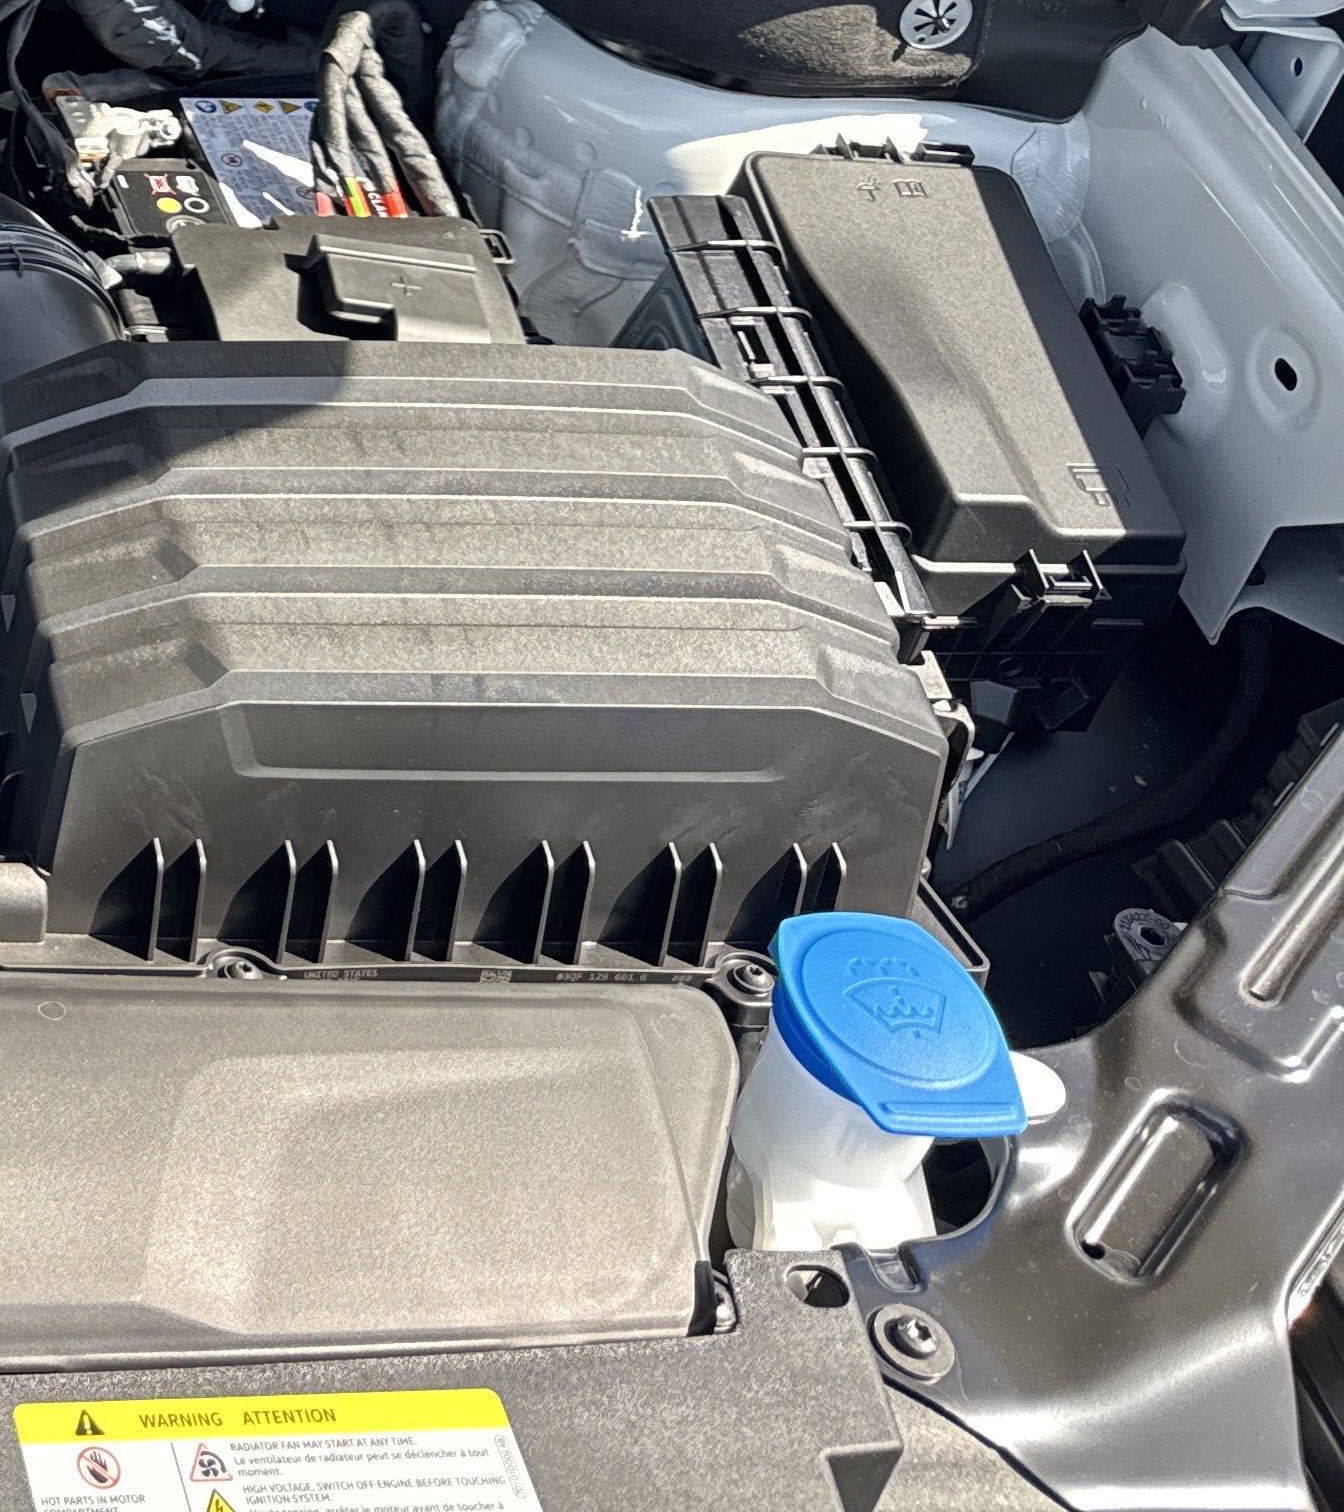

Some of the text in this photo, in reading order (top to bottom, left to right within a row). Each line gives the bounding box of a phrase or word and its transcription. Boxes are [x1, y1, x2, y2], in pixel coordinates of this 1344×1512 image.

[138, 1408, 336, 1429] WARNING ATTENTION
[230, 1440, 278, 1452] RADIATOR
[281, 1440, 300, 1450] FAN
[303, 1439, 323, 1450] MAY
[326, 1438, 354, 1449] START
[357, 1438, 368, 1447] AT
[370, 1437, 389, 1447] ANY
[234, 1456, 246, 1466] Le
[249, 1453, 302, 1465] ventilateur
[305, 1453, 317, 1464] de
[319, 1451, 363, 1463] radiateur
[367, 1451, 389, 1463] peut
[392, 1452, 402, 1460] se
[405, 1448, 457, 1460] déclencher
[468, 1447, 490, 1458] tout
[243, 1483, 268, 1494] HIGH
[316, 1481, 353, 1492] SWITCH
[356, 1480, 375, 1491] OFF
[378, 1478, 413, 1489] ENGINE
[416, 1477, 453, 1488] BEFORE
[456, 1475, 506, 1487] TOUCHING
[41, 1494, 146, 1506] HOT PARTS IN MOTOR
[246, 1493, 291, 1505] IGNITION
[413, 1504, 439, 1512] avant
[443, 1502, 455, 1512] de
[457, 1501, 495, 1512] toucher
